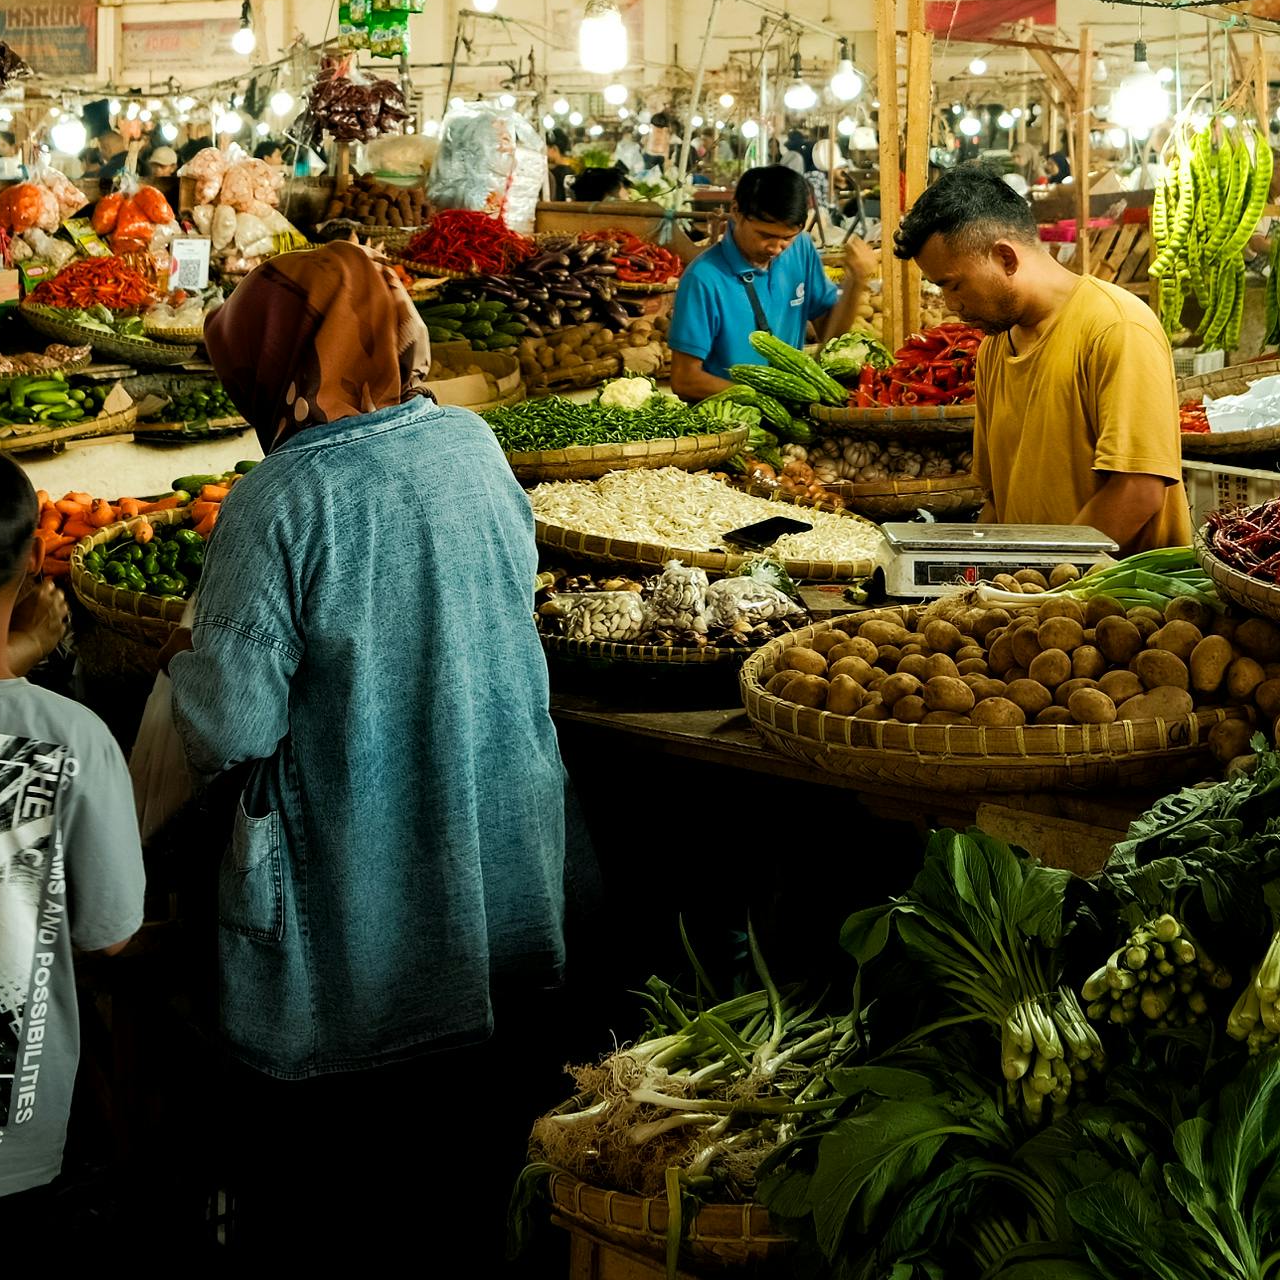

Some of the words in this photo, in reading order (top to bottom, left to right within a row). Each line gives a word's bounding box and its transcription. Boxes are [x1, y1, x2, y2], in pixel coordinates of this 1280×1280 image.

[22, 753, 63, 818] THE
[37, 899, 65, 945] AND
[15, 951, 55, 1125] POSSIBILITIES
